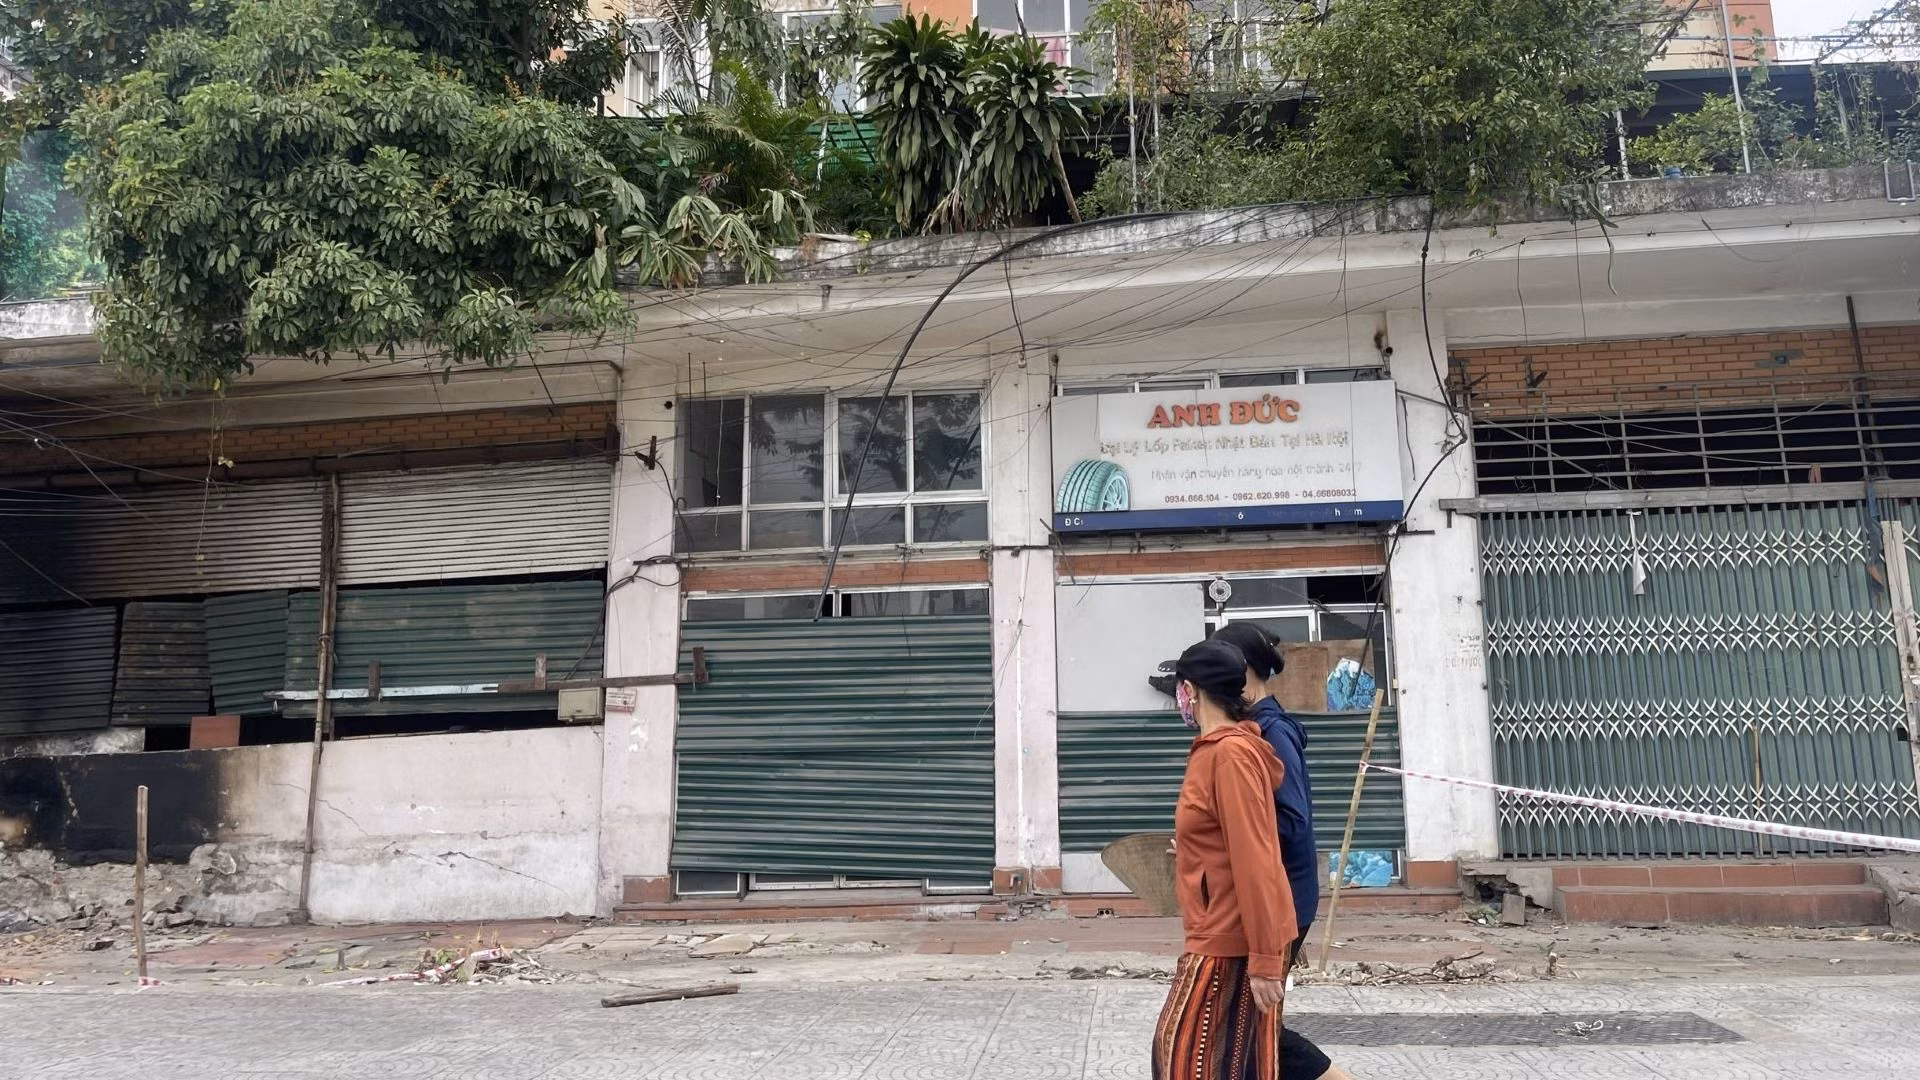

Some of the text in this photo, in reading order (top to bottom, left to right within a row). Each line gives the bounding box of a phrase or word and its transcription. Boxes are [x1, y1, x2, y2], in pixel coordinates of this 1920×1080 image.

[1147, 394, 1300, 429] ANH ĐỨC
[1144, 438, 1169, 454] Lốp
[1164, 493, 1220, 504] 0934.666.104
